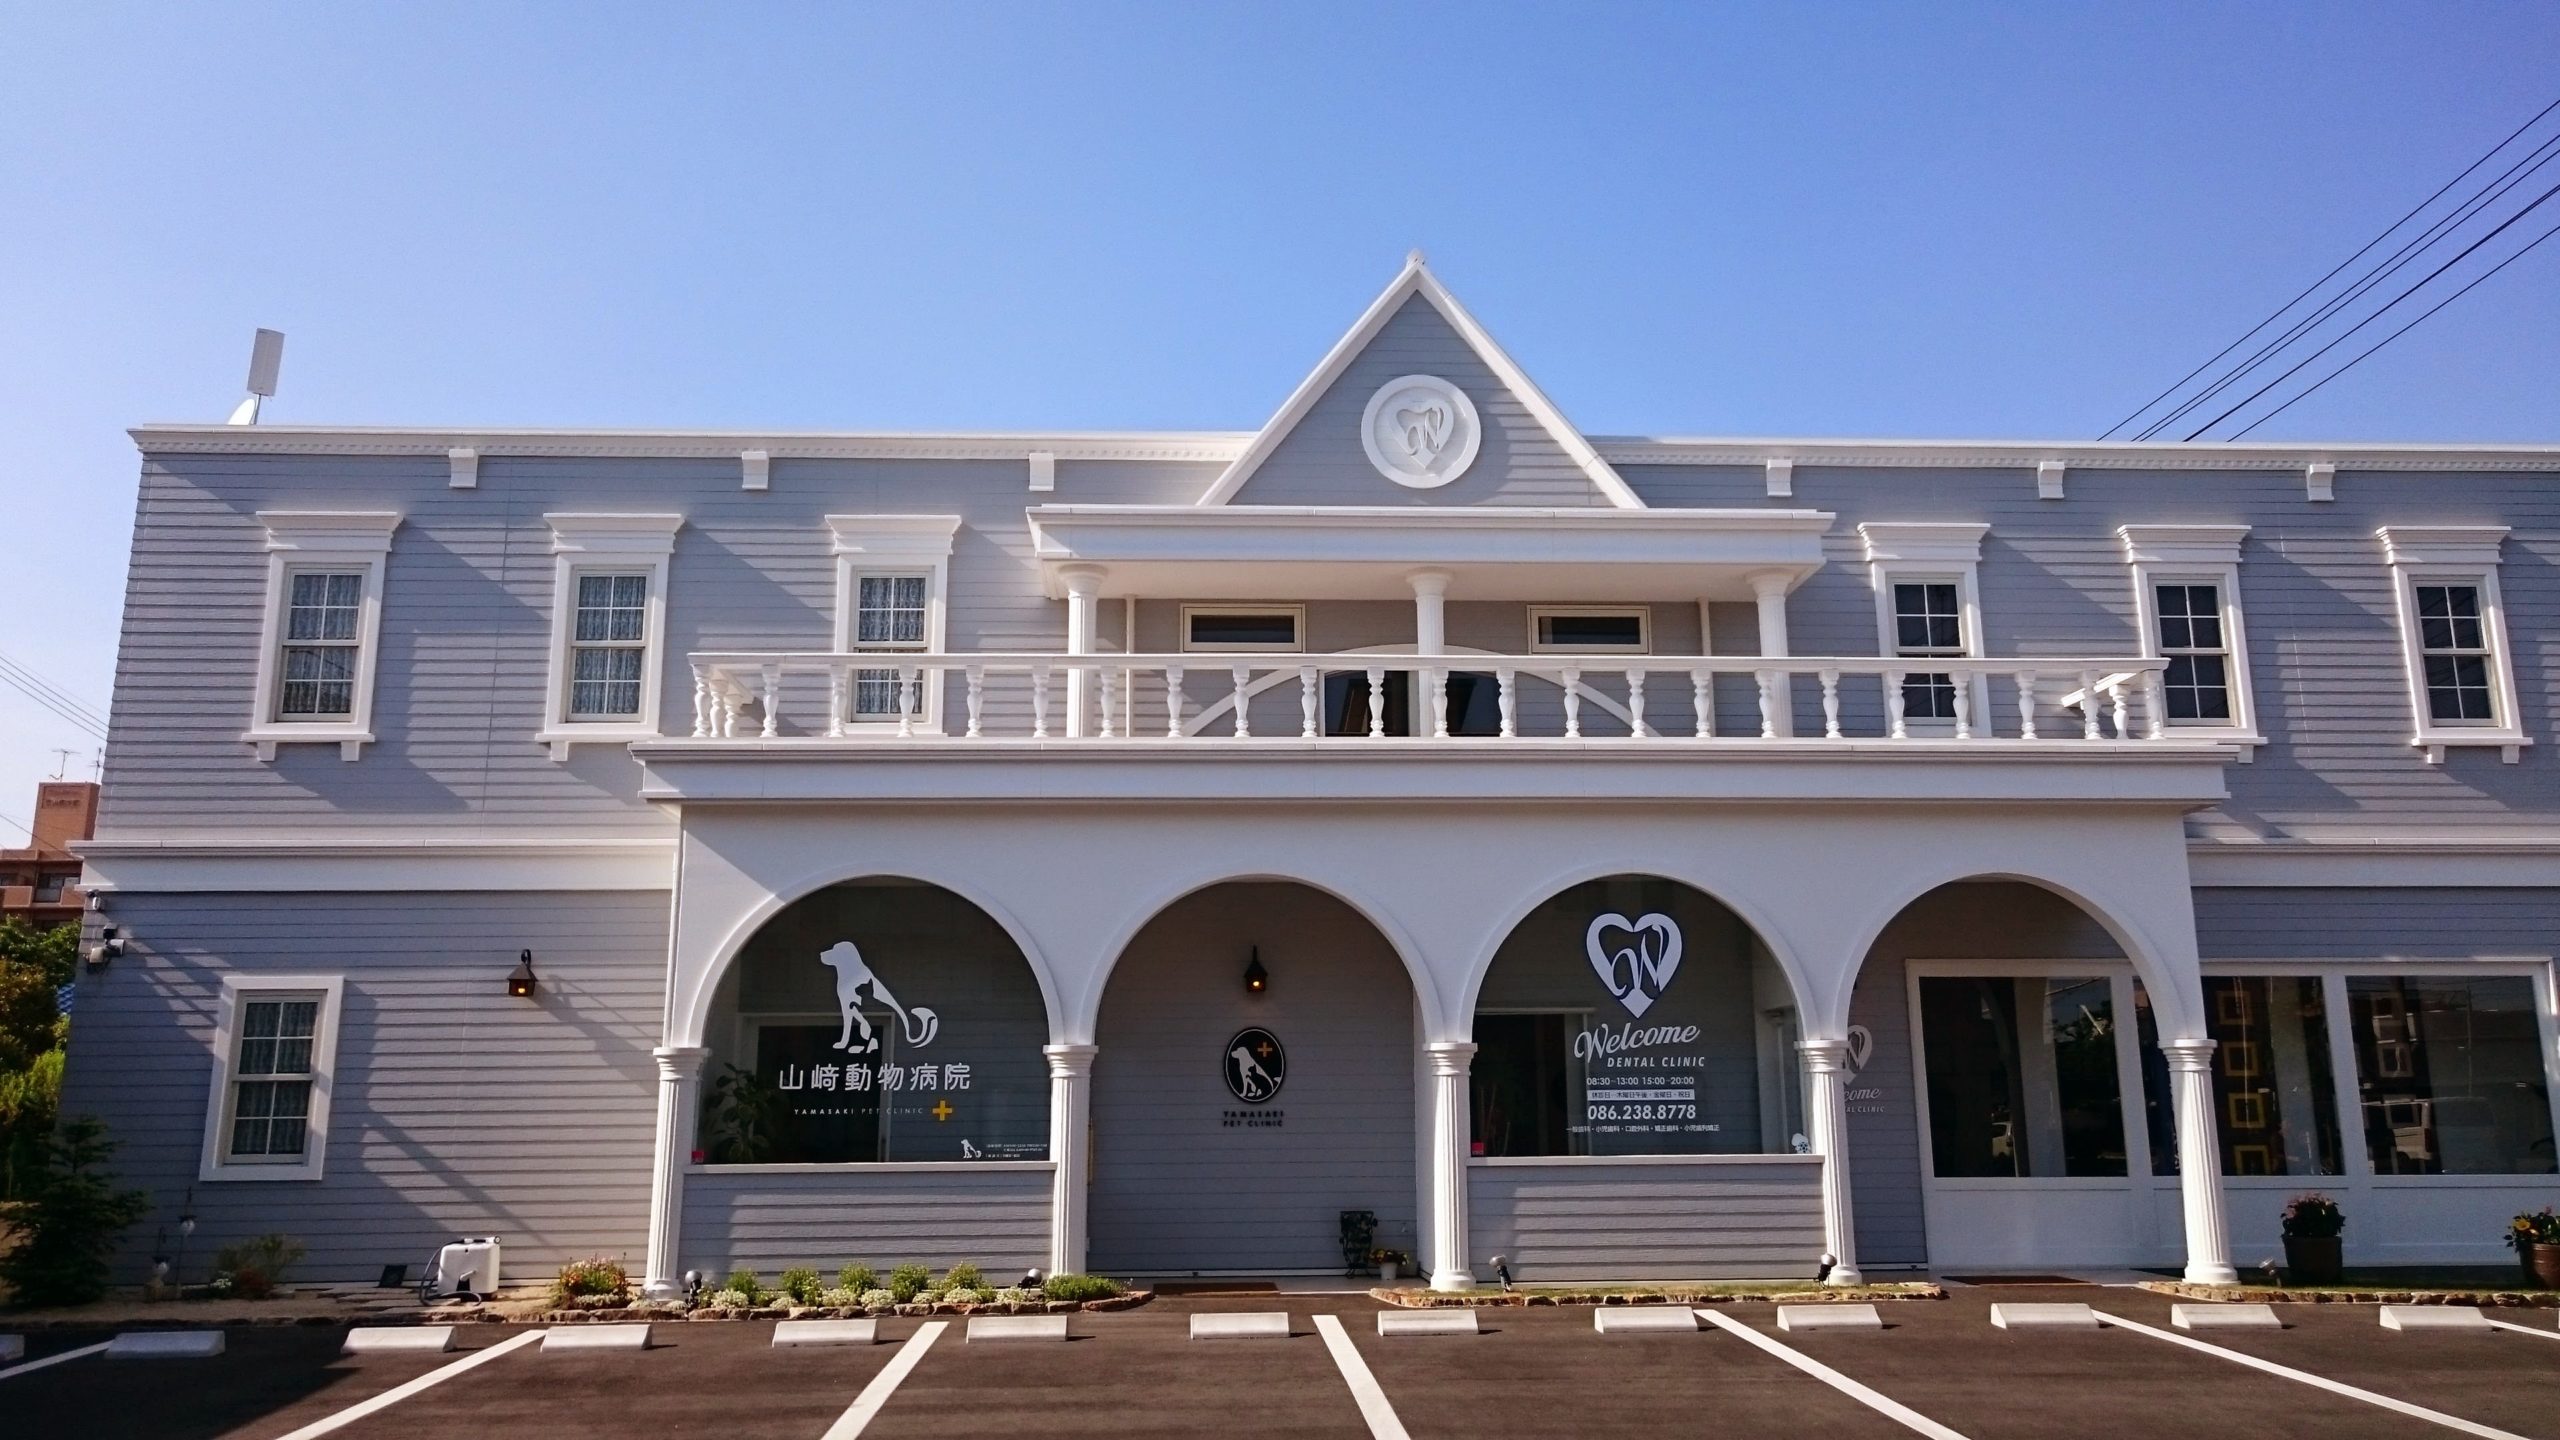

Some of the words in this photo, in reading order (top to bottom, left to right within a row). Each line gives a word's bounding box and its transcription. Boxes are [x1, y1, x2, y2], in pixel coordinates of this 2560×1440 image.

[1574, 1022, 1701, 1064] Welcome
[1607, 1057, 1656, 1068] DENTAL
[1661, 1056, 1705, 1068] CLINIC
[1587, 1104, 1696, 1120] 086.238.8778
